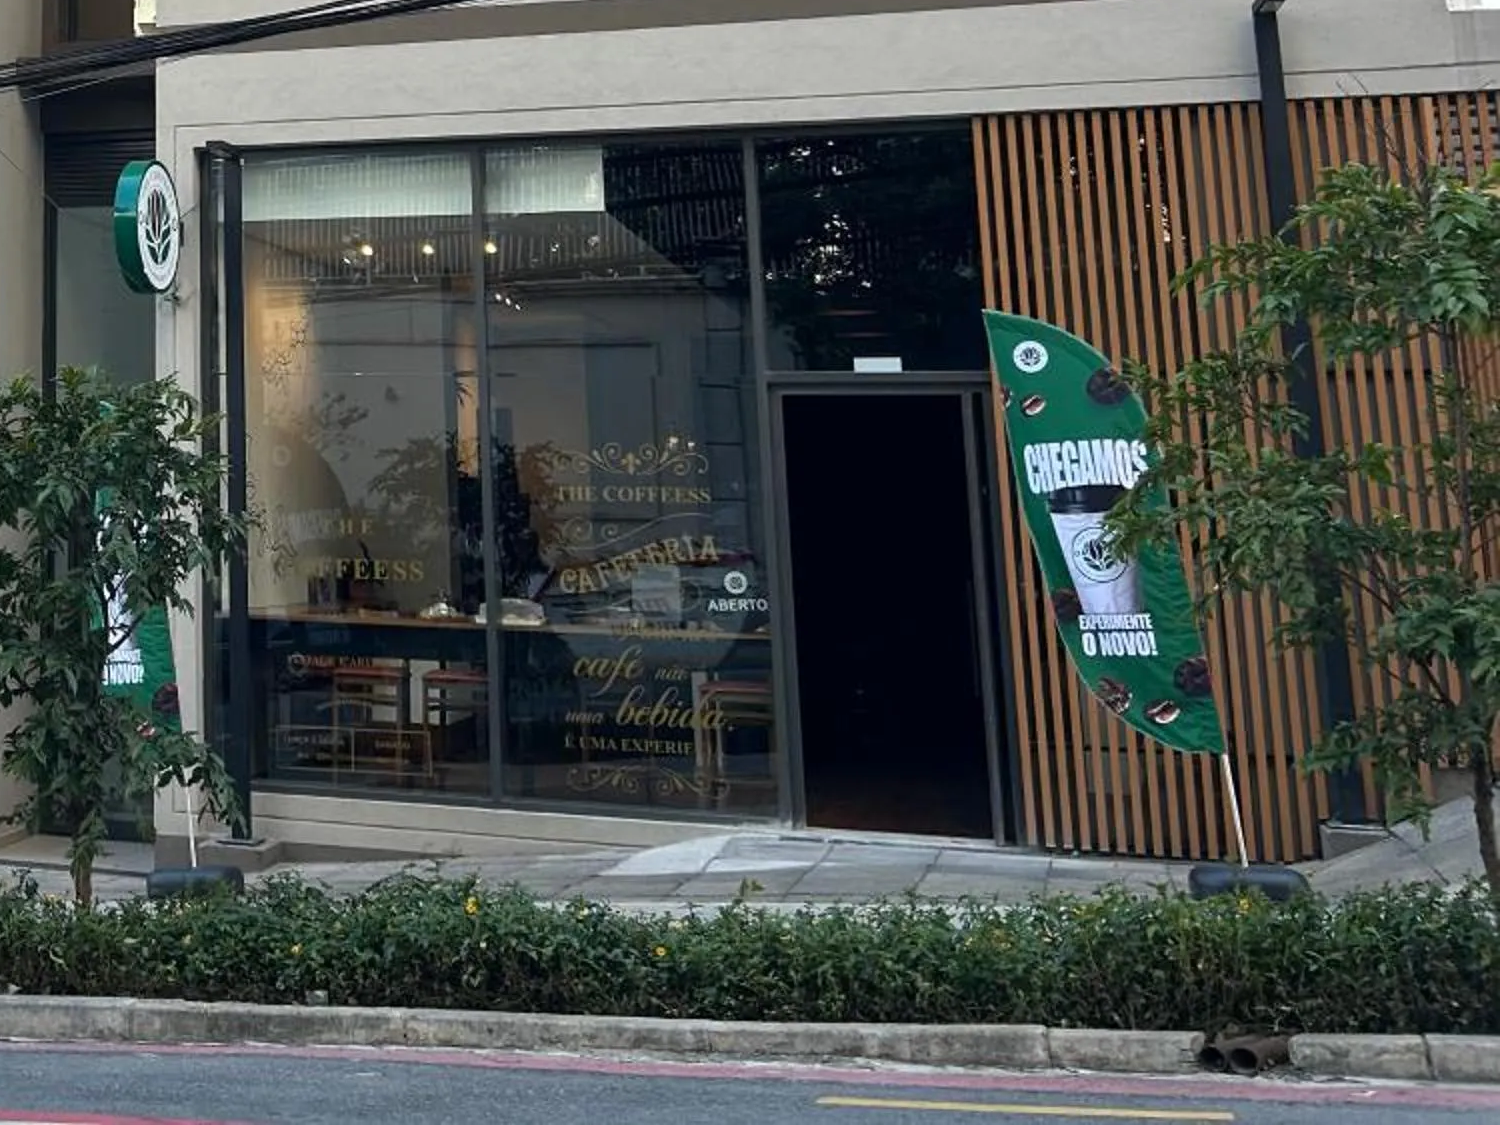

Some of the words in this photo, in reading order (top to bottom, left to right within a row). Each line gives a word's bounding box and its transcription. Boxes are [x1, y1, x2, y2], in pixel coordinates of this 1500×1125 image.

[1023, 438, 1149, 495] CHEGAMOS
[558, 485, 598, 503] THE
[602, 485, 712, 504] COFFEESS
[560, 534, 720, 595] CAFETERIA
[707, 598, 769, 612] ABERTO
[1078, 613, 1152, 630] EXPERIMENTE
[1082, 632, 1097, 656] O
[1102, 630, 1158, 656] NOVO!
[573, 644, 644, 698] café
